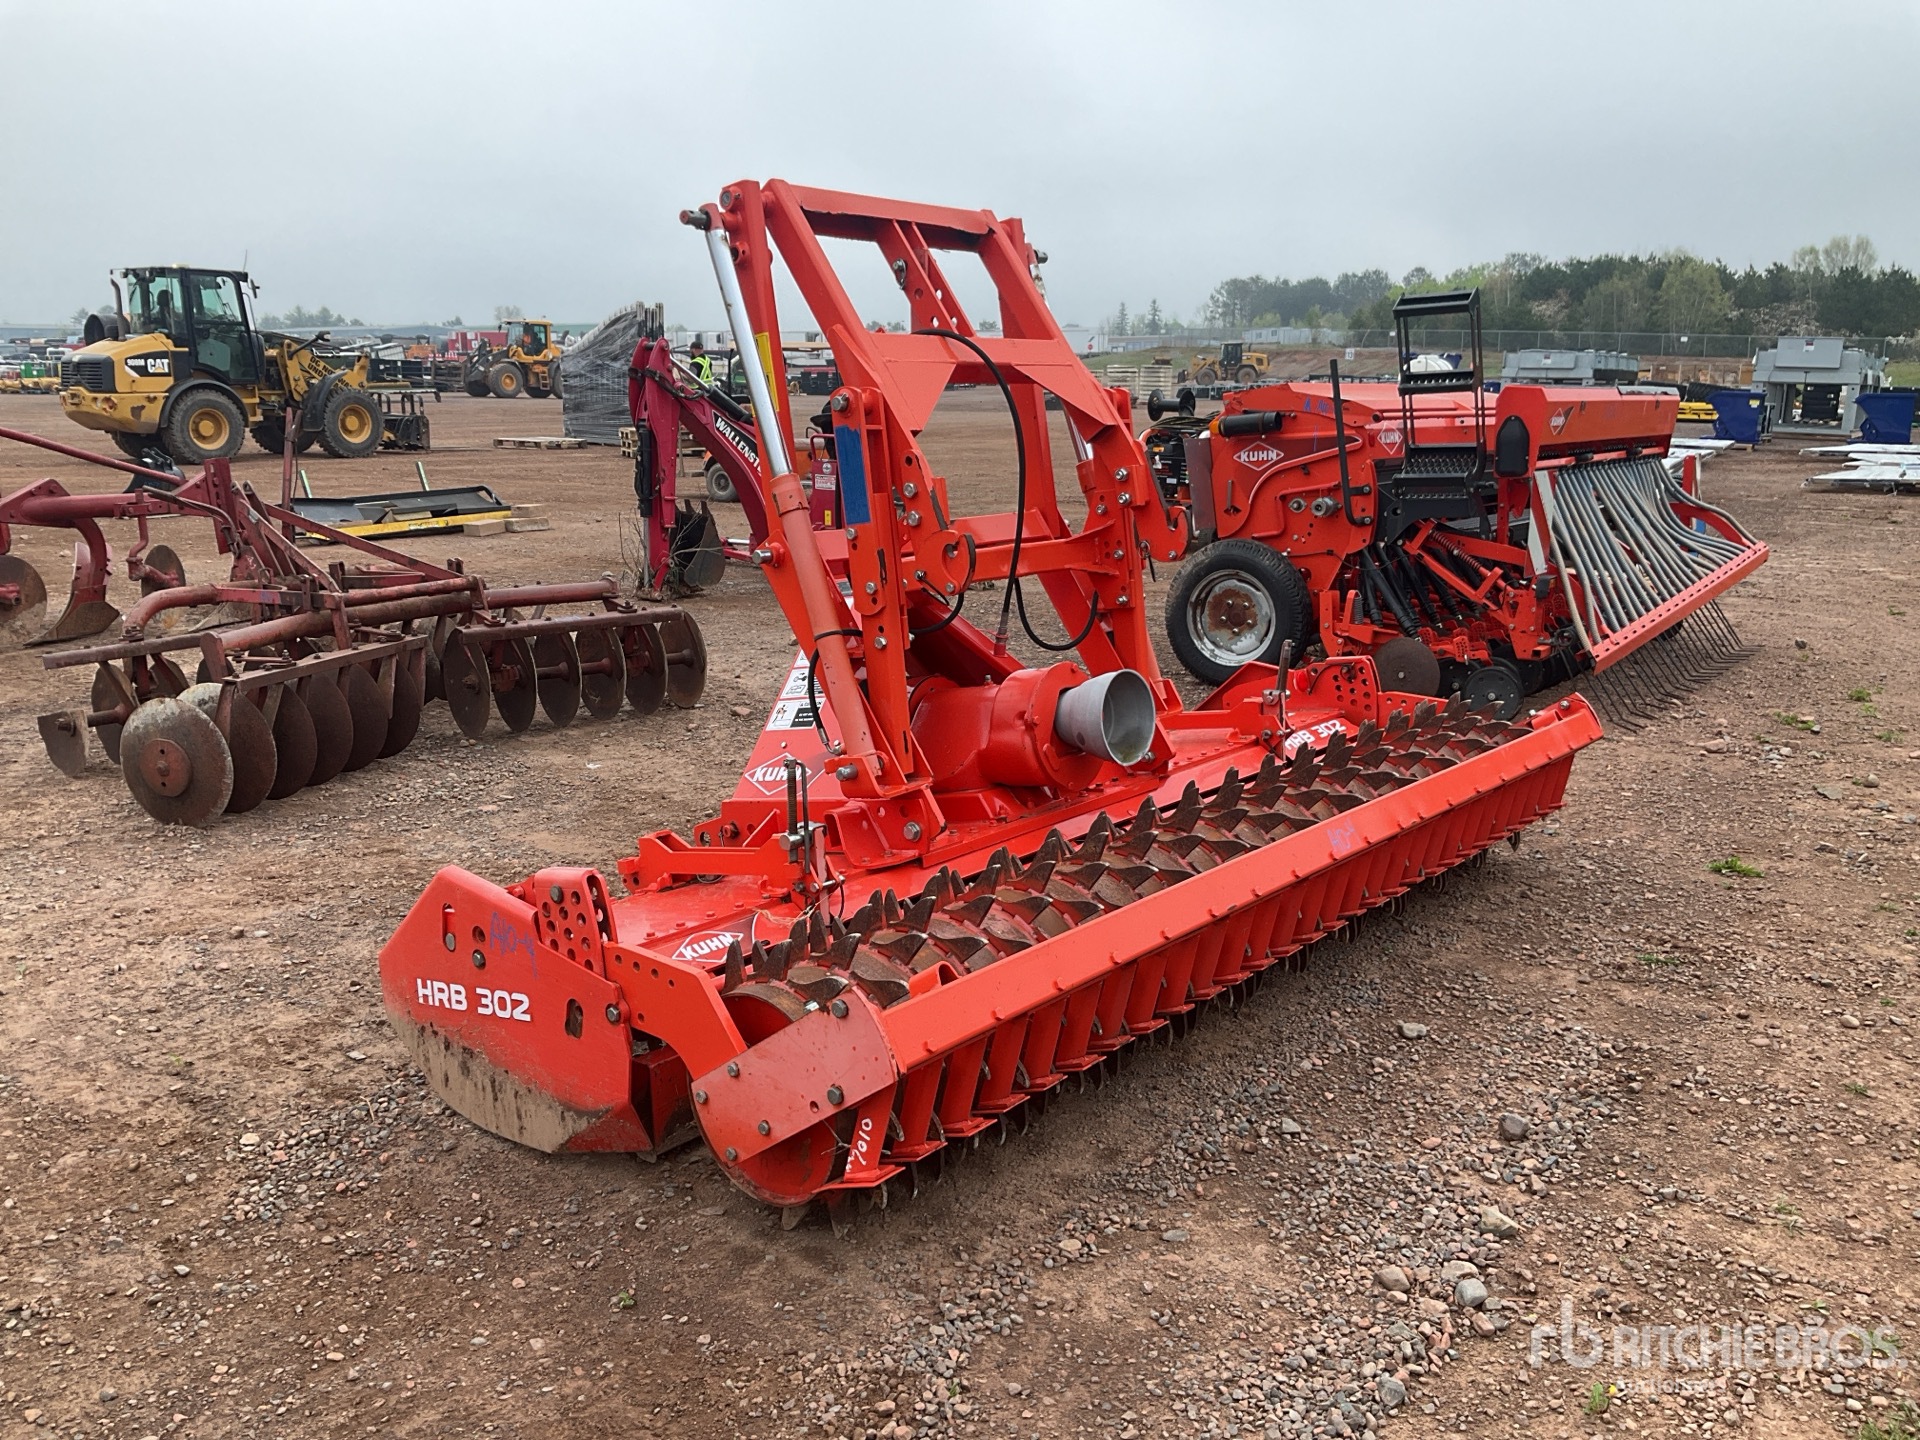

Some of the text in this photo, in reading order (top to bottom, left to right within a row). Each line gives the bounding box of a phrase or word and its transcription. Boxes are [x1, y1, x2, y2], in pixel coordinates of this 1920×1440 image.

[147, 358, 169, 373] CAT
[1380, 431, 1400, 444] KUHN
[1240, 449, 1277, 462] KUHN
[1311, 720, 1346, 738] 302
[680, 932, 734, 960] KUHN
[416, 978, 531, 1022] HRB 302
